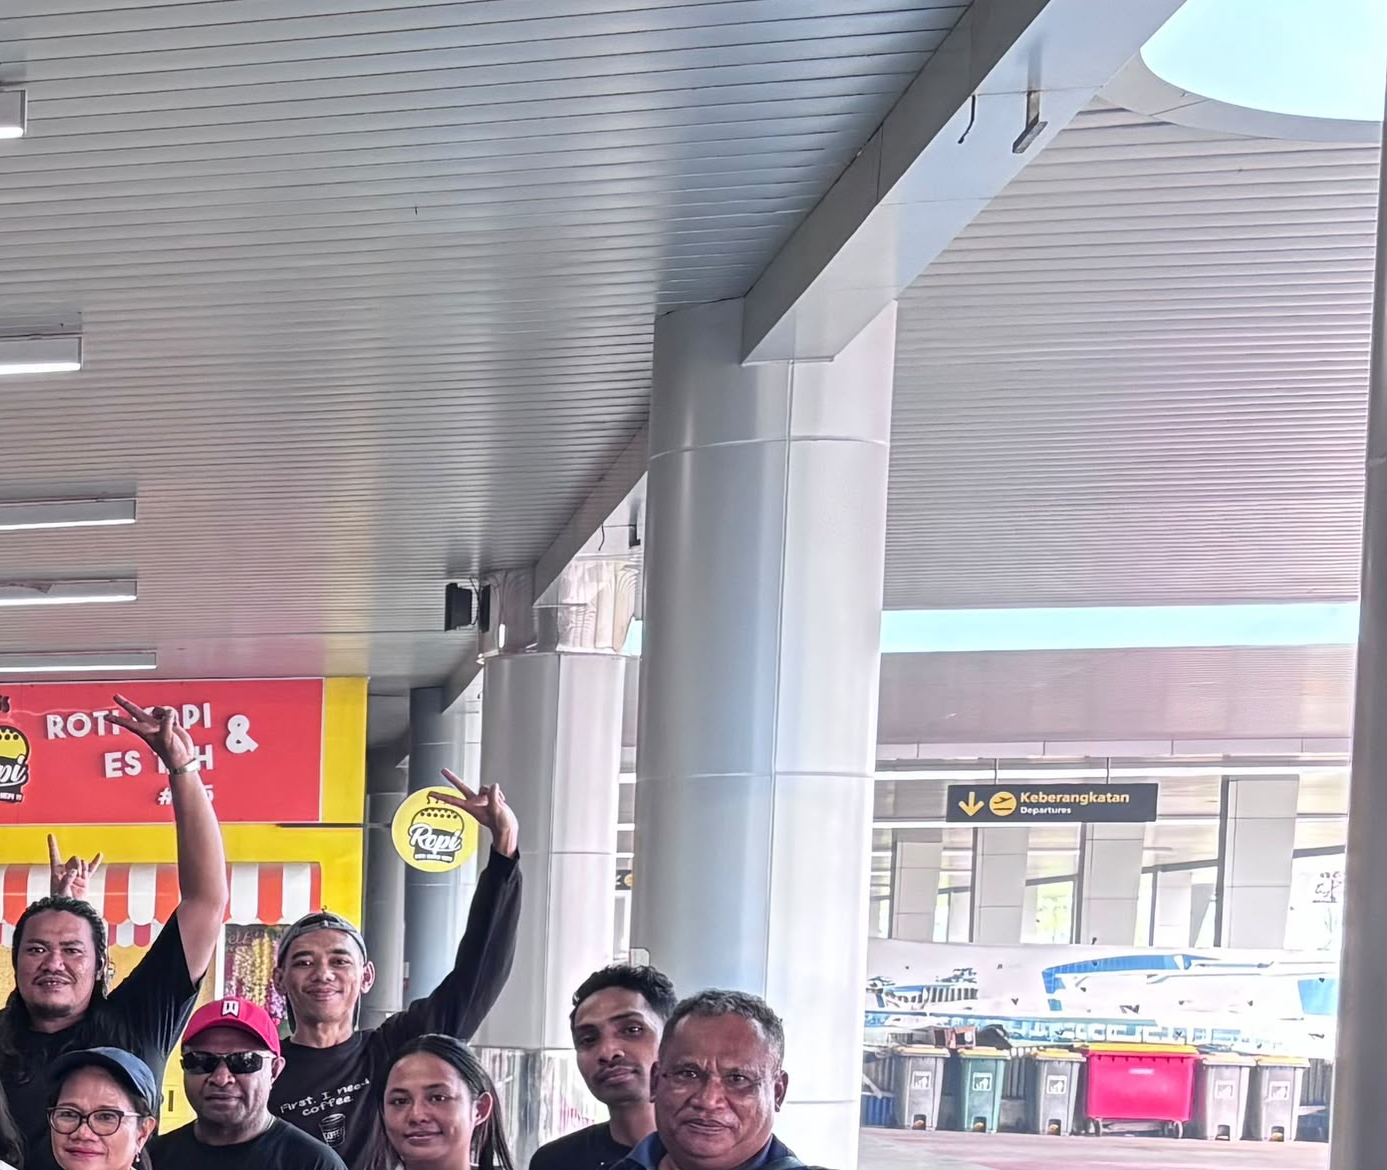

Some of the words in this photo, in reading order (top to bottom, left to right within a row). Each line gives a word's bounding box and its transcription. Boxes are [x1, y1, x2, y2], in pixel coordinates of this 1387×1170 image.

[46, 709, 121, 740] ROTI
[225, 714, 259, 754] &
[104, 750, 142, 778] ES
[153, 745, 214, 775] TH
[1020, 791, 1130, 806] Keberangkatan
[1020, 806, 1072, 816] Departures
[409, 823, 462, 855] Ropi
